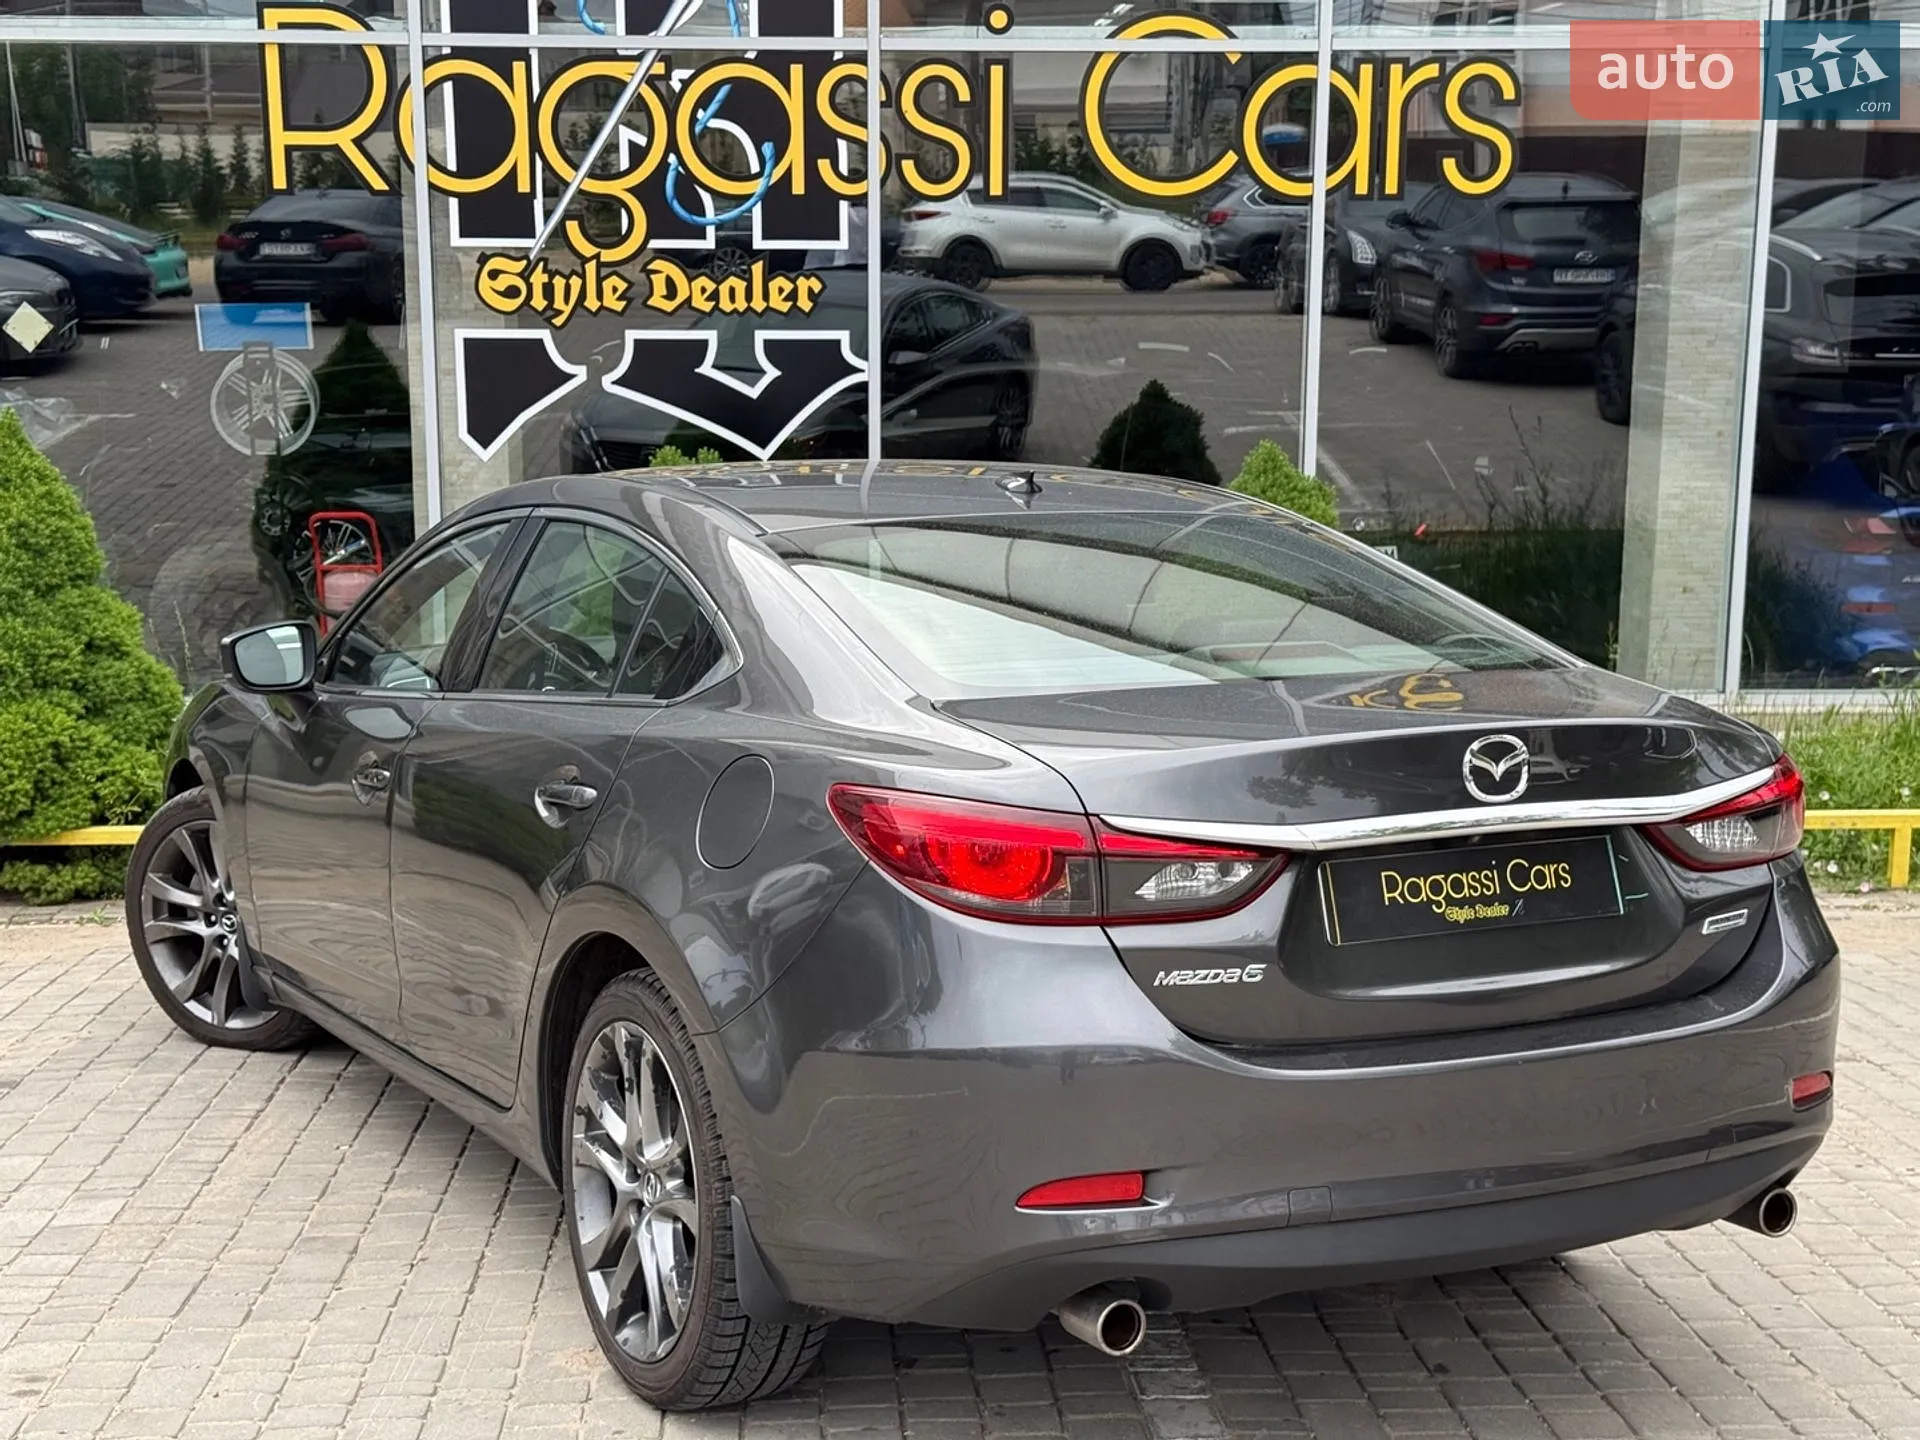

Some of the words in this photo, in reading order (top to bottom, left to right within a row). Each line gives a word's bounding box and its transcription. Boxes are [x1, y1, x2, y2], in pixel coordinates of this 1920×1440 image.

[260, 6, 1008, 264] Ragassi
[1082, 14, 1519, 198] Cars
[477, 251, 634, 328] Style
[644, 257, 823, 315] Dealer
[1380, 859, 1501, 914] Ragassi
[1506, 858, 1573, 892] Cars
